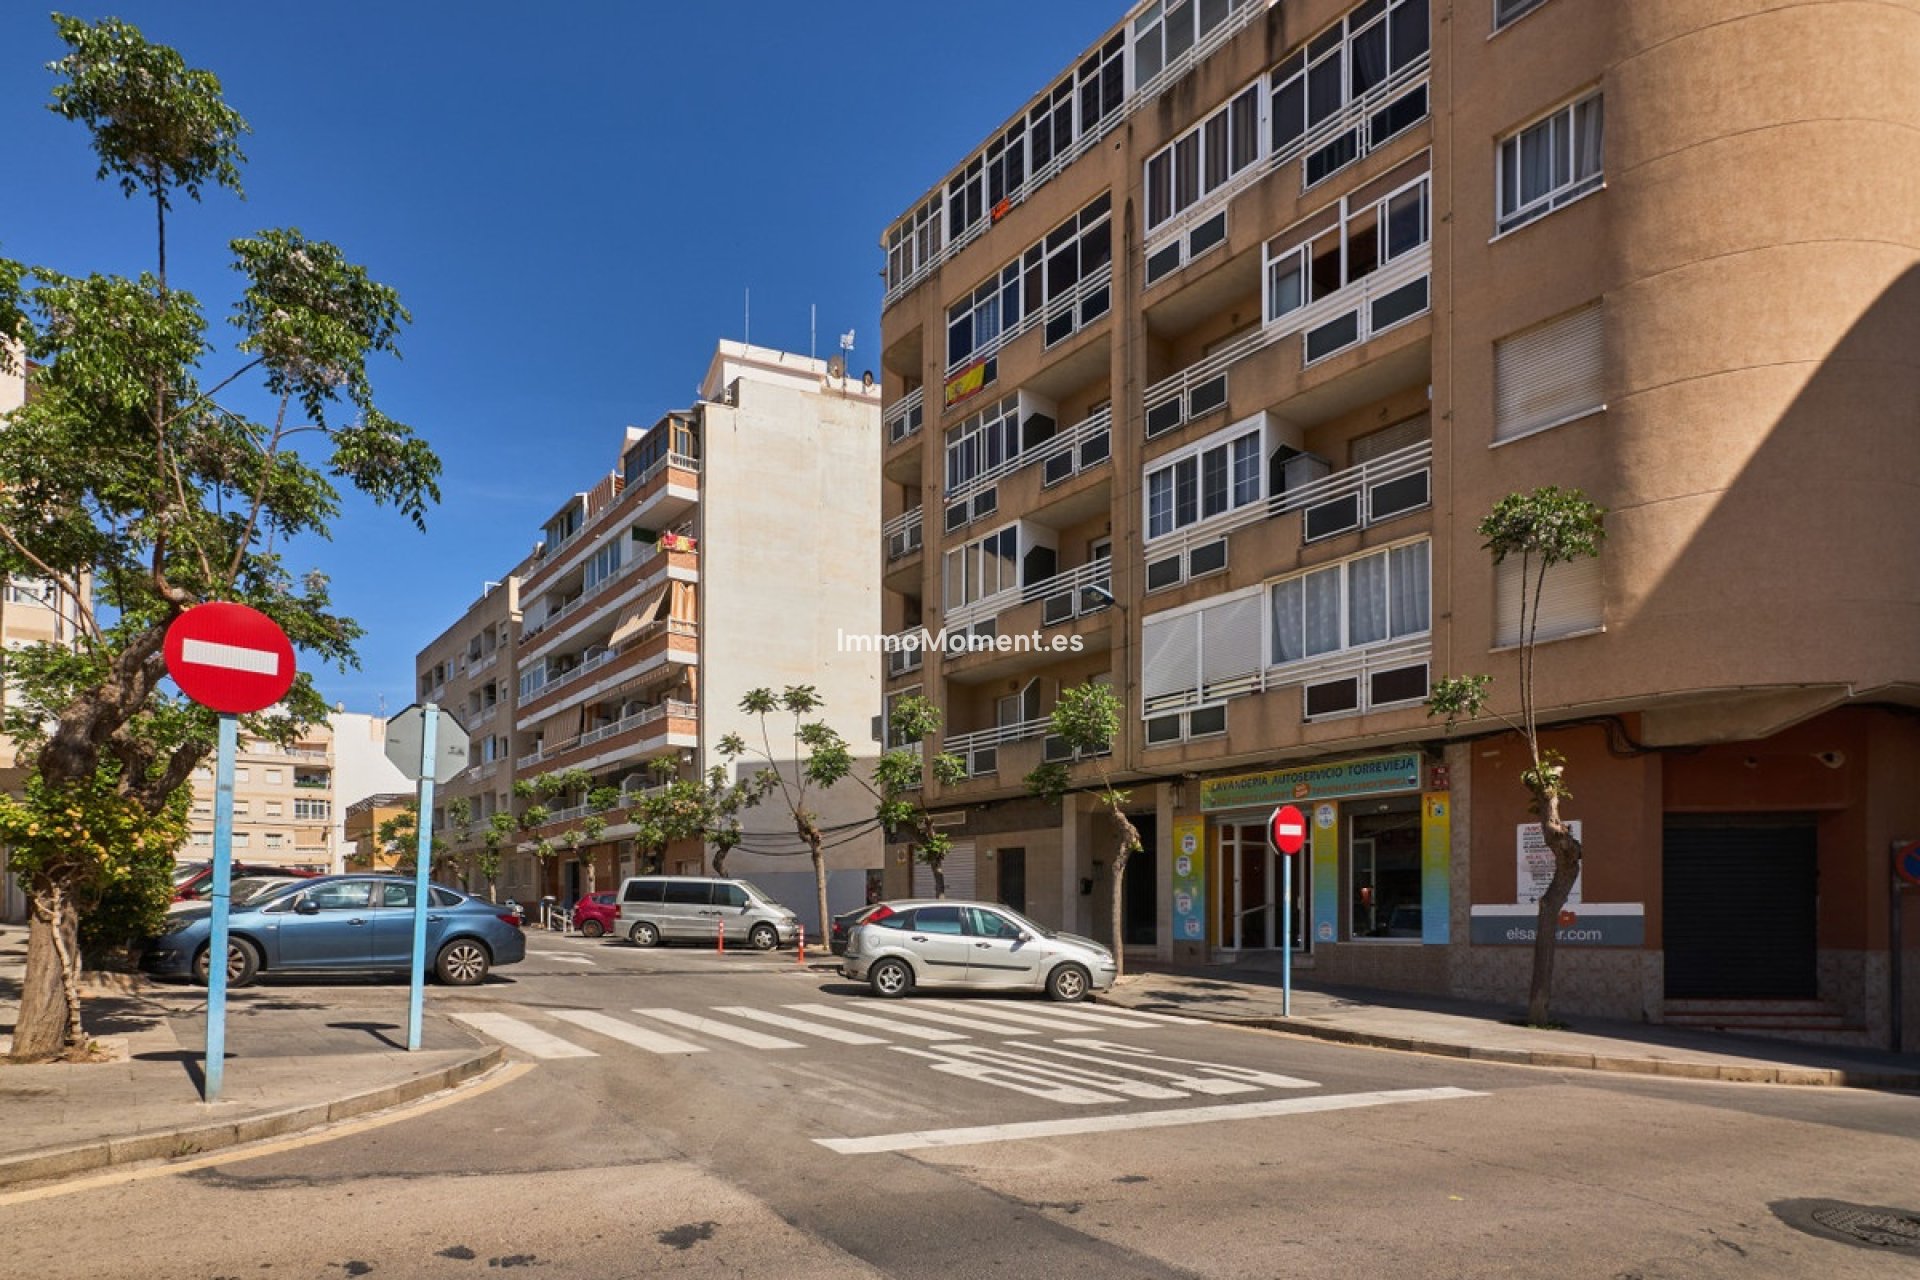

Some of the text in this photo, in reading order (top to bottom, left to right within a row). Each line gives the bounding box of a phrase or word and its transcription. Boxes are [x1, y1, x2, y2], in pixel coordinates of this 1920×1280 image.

[1272, 768, 1343, 785] AUTOSERVICIO
[1348, 758, 1415, 776] TORREVIEJA
[888, 1039, 1322, 1104] STOP
